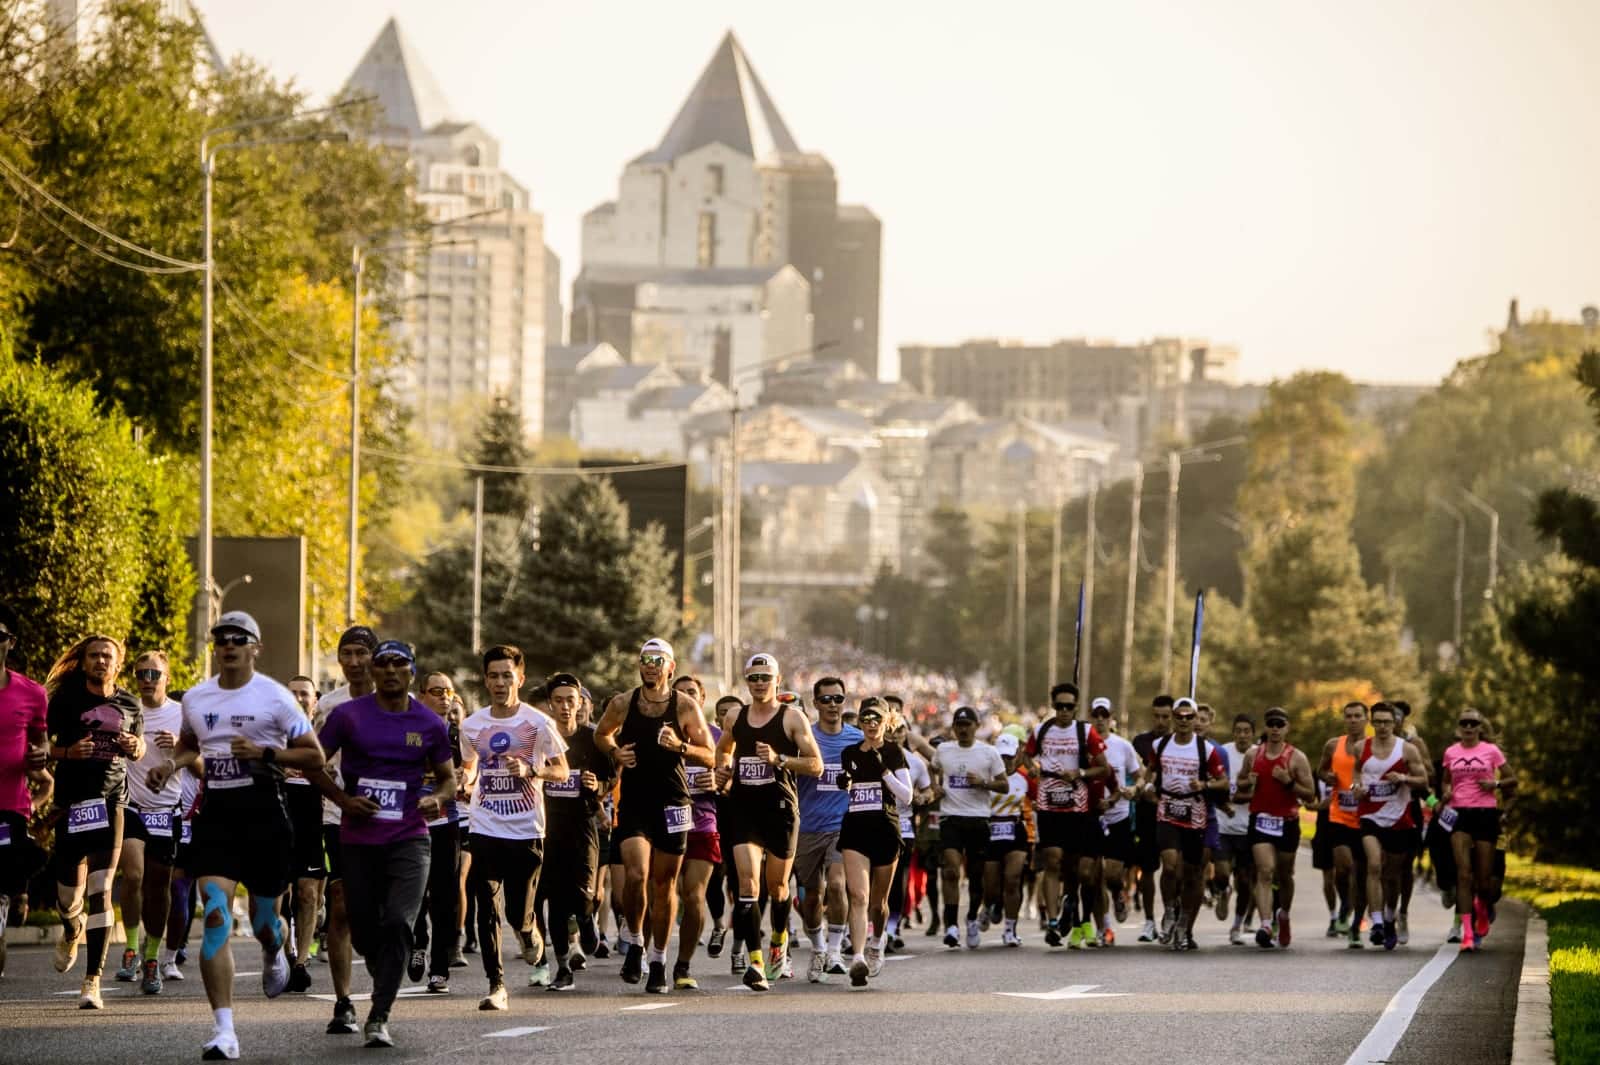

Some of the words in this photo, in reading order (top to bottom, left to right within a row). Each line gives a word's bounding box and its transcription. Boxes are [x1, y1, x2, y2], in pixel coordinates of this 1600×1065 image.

[212, 759, 241, 777] 2241
[745, 764, 766, 777] 2917
[490, 777, 514, 790] 3001
[364, 788, 397, 807] 2184
[854, 789, 874, 802] 2614
[74, 806, 100, 822] 3501
[144, 814, 168, 826] 2638
